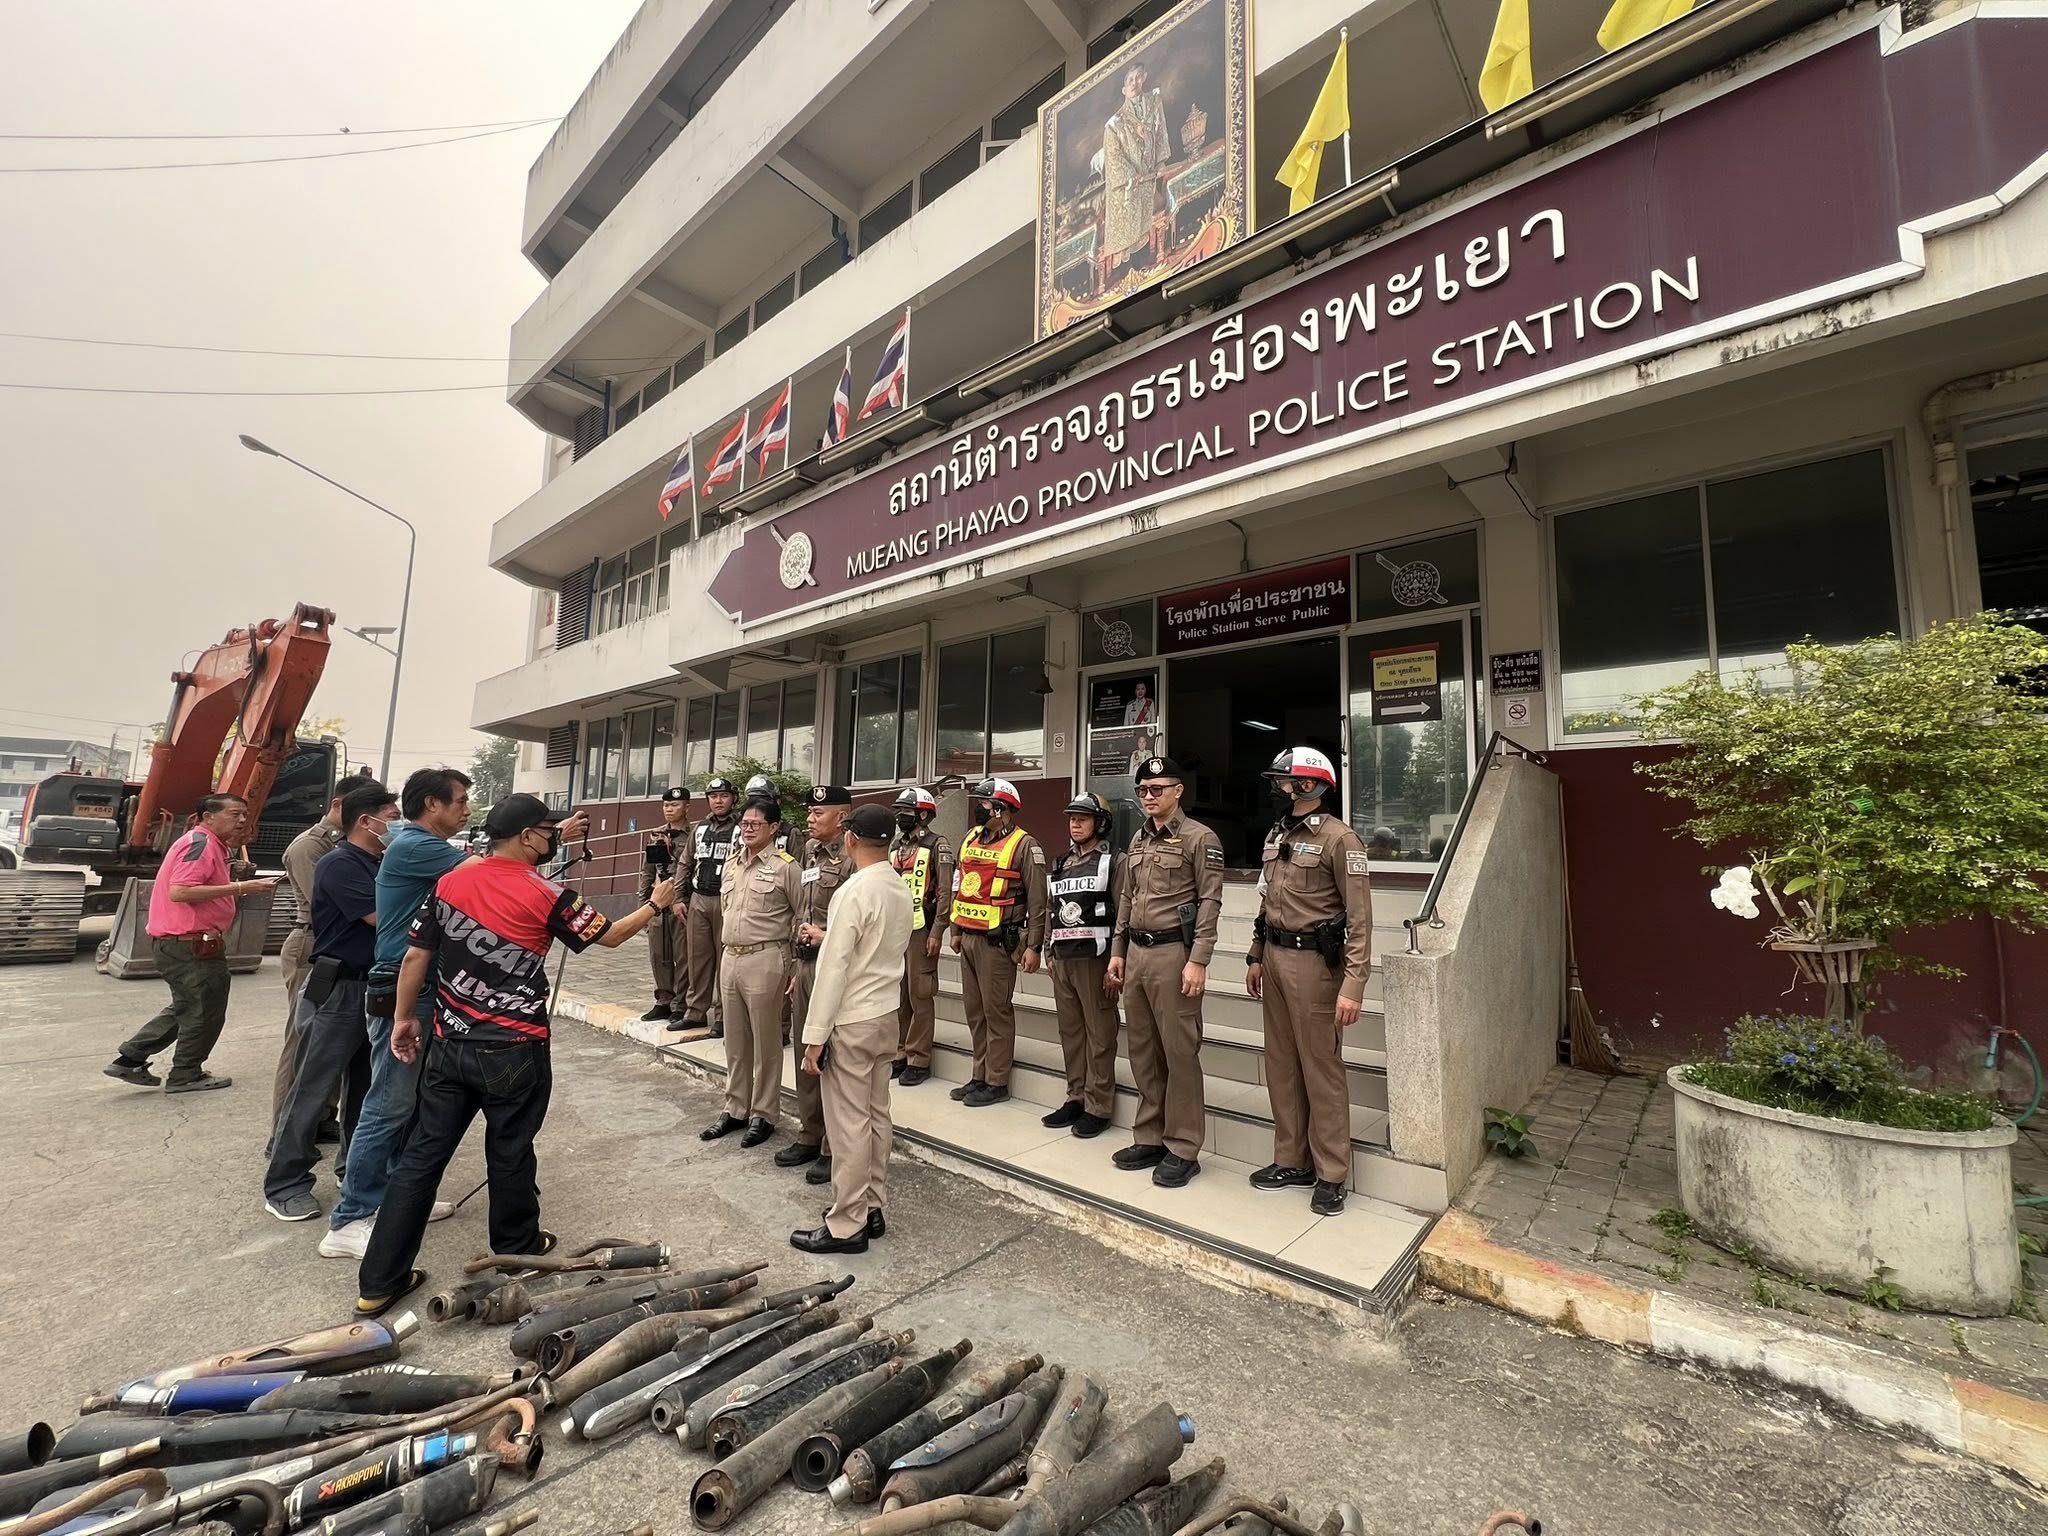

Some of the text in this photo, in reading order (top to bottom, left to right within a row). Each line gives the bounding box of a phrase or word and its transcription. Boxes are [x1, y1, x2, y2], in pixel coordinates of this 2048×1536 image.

[888, 208, 1567, 516] สถานีตำรวจภูธรเมืองพะเยา
[846, 255, 1700, 579] MUEANG PHAYAO PROVINCIAL POLICE STATION
[1166, 579, 1346, 626] โรงพักเพื่อประชาชน
[1178, 605, 1330, 641] Police Station Serve Public
[1407, 690, 1419, 698] 24
[1305, 757, 1323, 767] 621
[912, 859, 926, 913] POLICE
[1054, 877, 1096, 895] POLICE
